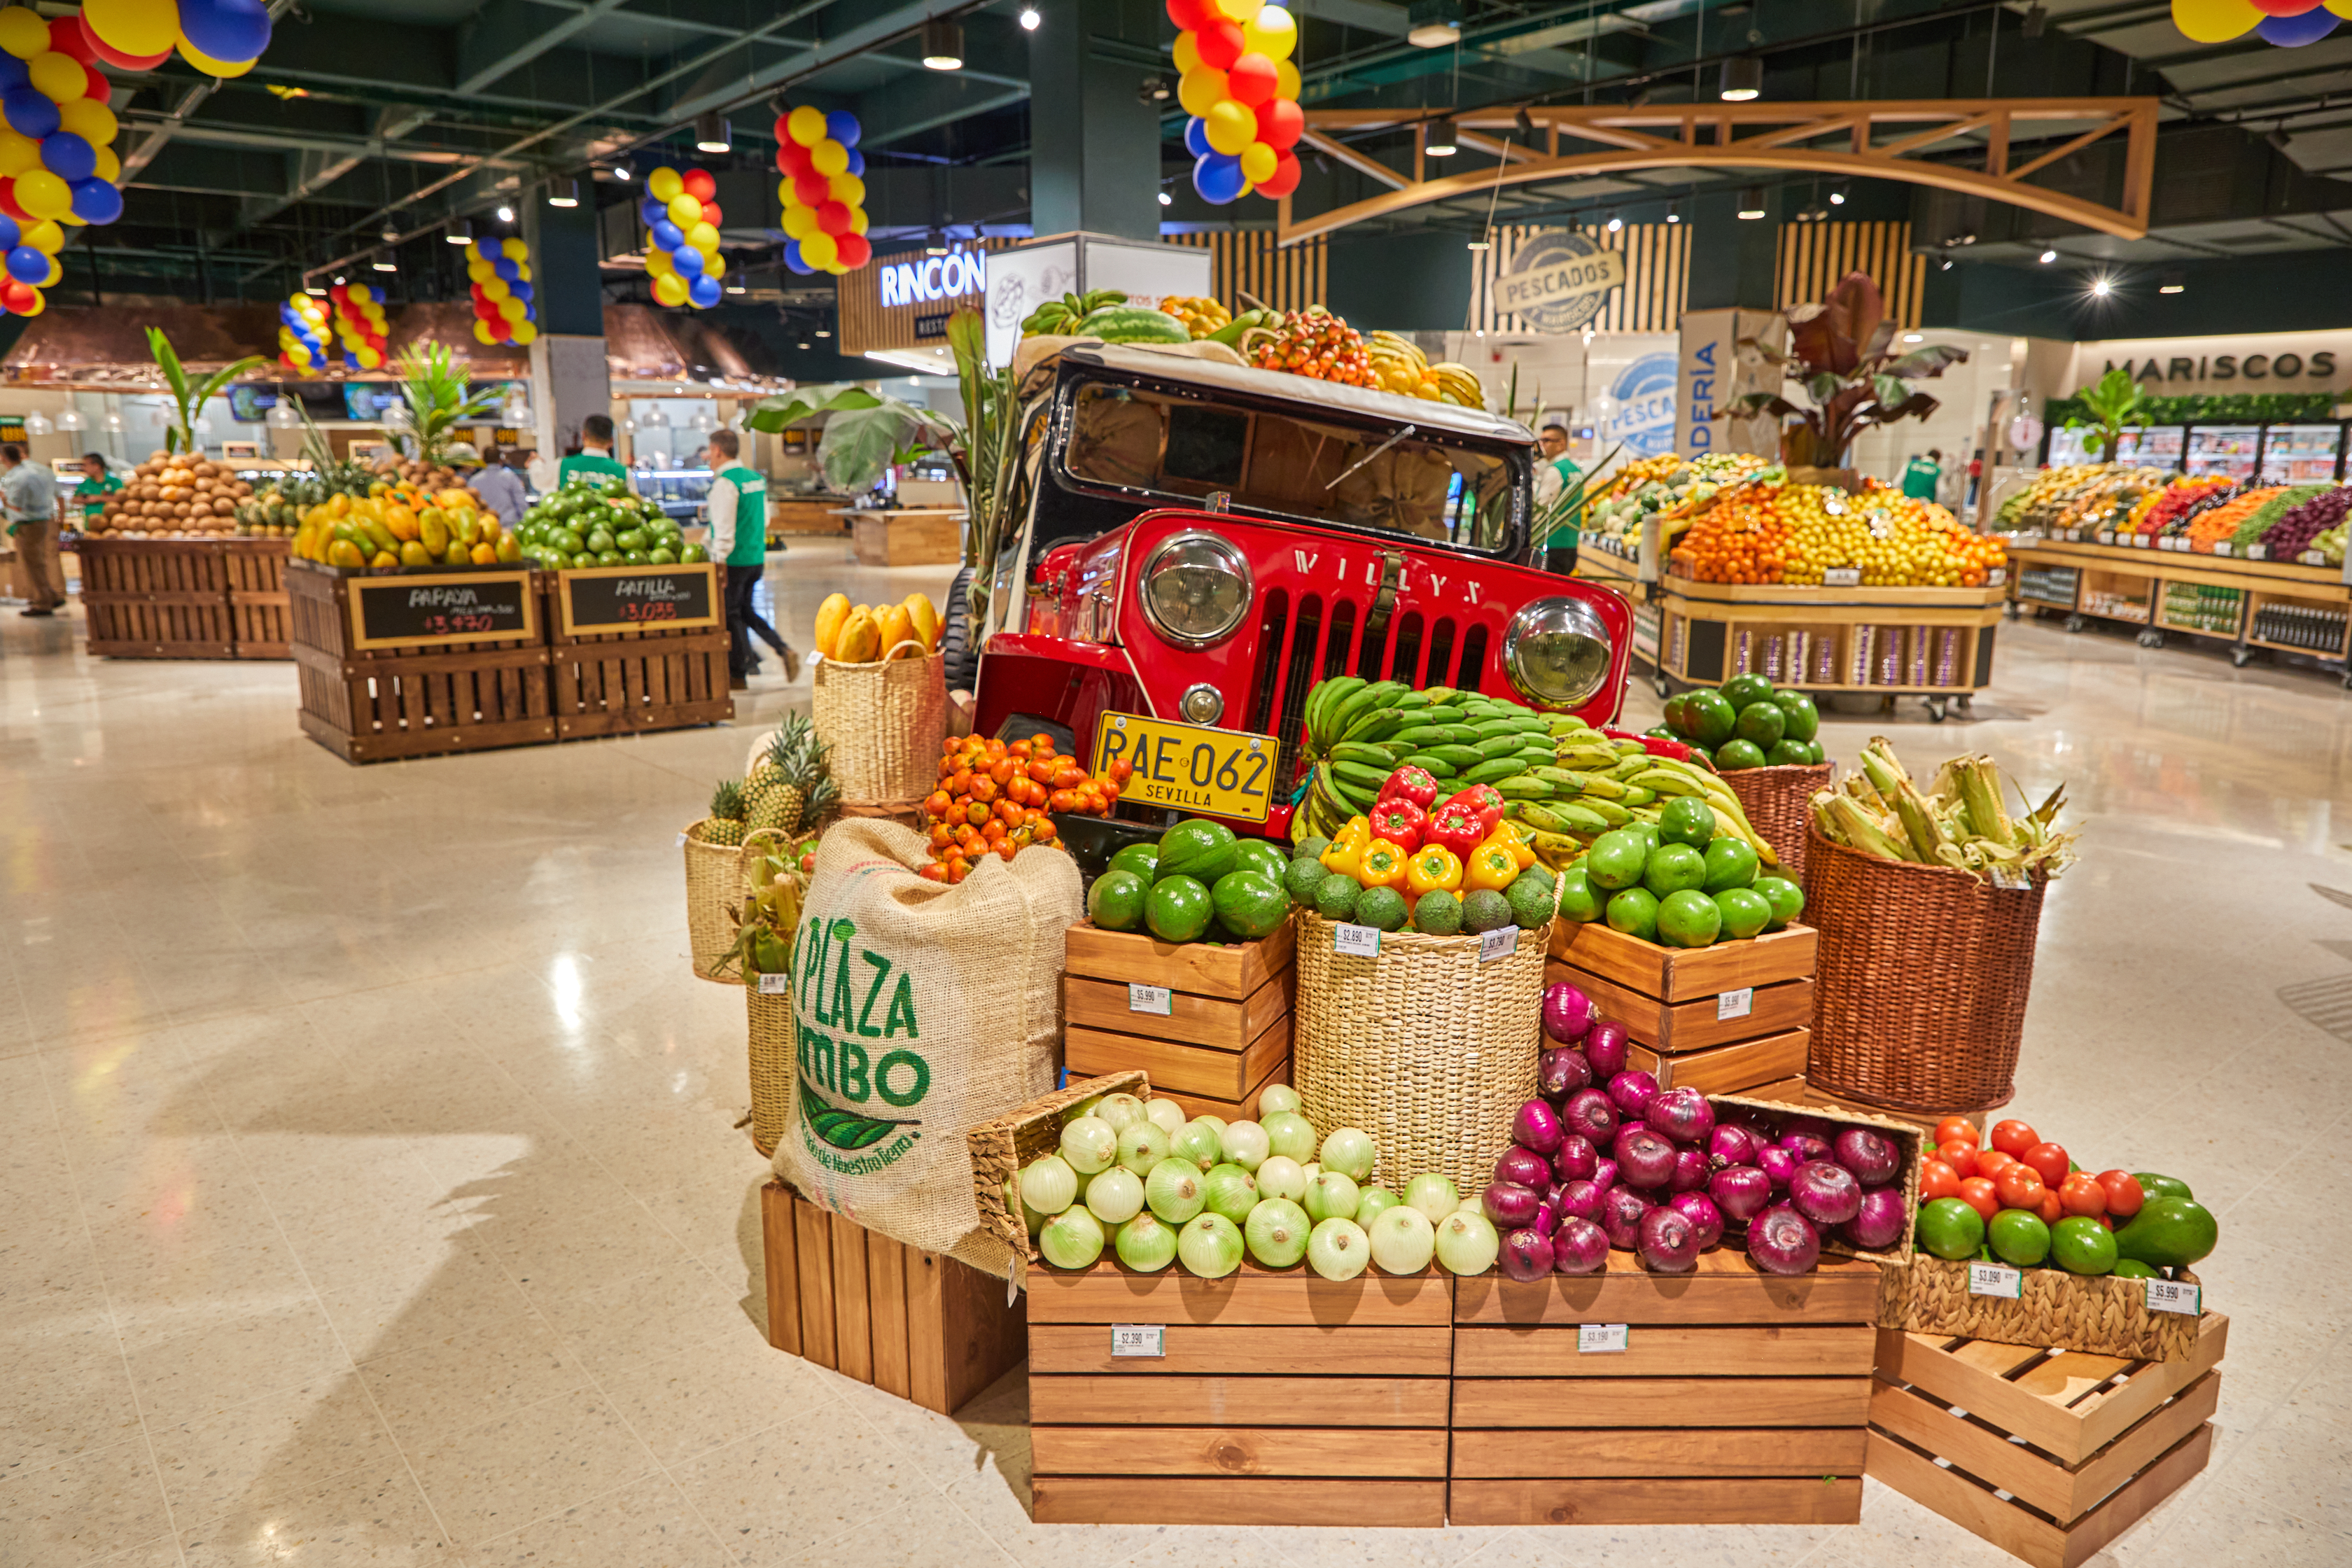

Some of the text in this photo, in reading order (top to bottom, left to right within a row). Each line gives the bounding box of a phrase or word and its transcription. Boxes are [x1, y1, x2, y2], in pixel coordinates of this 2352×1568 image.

[881, 243, 986, 307] RINCÓN
[1506, 260, 1609, 304] PESCADOS
[2103, 352, 2336, 382] MARISCOS
[615, 578, 676, 596] PATILLA
[1294, 550, 1480, 604] WILLYS
[409, 587, 478, 608] PAPAYA
[1190, 742, 1268, 797] 062
[1146, 784, 1211, 806] SEVILLA
[1343, 929, 1362, 942] $2.890
[801, 916, 919, 1040] PLAZA
[1137, 989, 1155, 1002] $5.990
[1979, 1269, 2001, 1284] $3.090
[2156, 1284, 2178, 1299] $5.990
[1121, 1333, 1142, 1344] $2.390
[1588, 1331, 1609, 1342] $3.190
